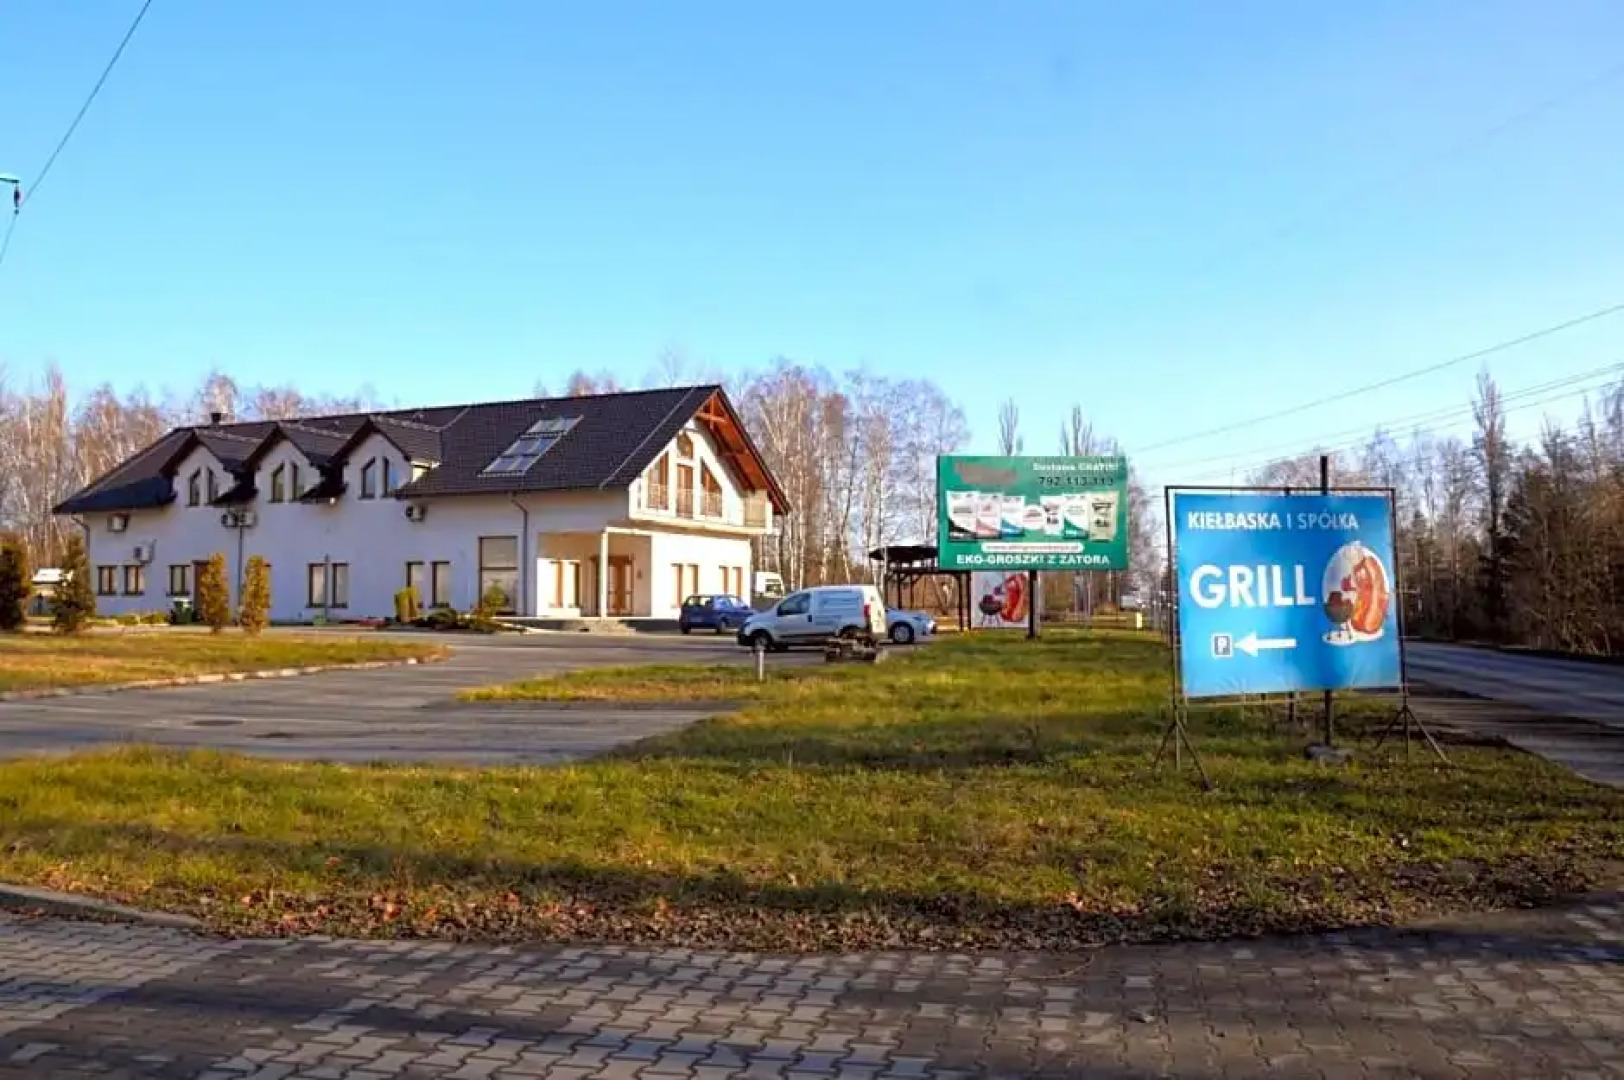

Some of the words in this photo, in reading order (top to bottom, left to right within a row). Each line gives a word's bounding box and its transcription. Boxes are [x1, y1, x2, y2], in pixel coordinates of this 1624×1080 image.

[1188, 511, 1282, 530] KIEŁBASKA
[1286, 512, 1292, 529] I
[1297, 508, 1359, 531] SPÓŁKA
[956, 554, 1044, 565] EKO-GROSZKI
[1048, 555, 1058, 565] Z
[1060, 554, 1110, 565] ZATORA
[1189, 564, 1315, 609] GRILL
